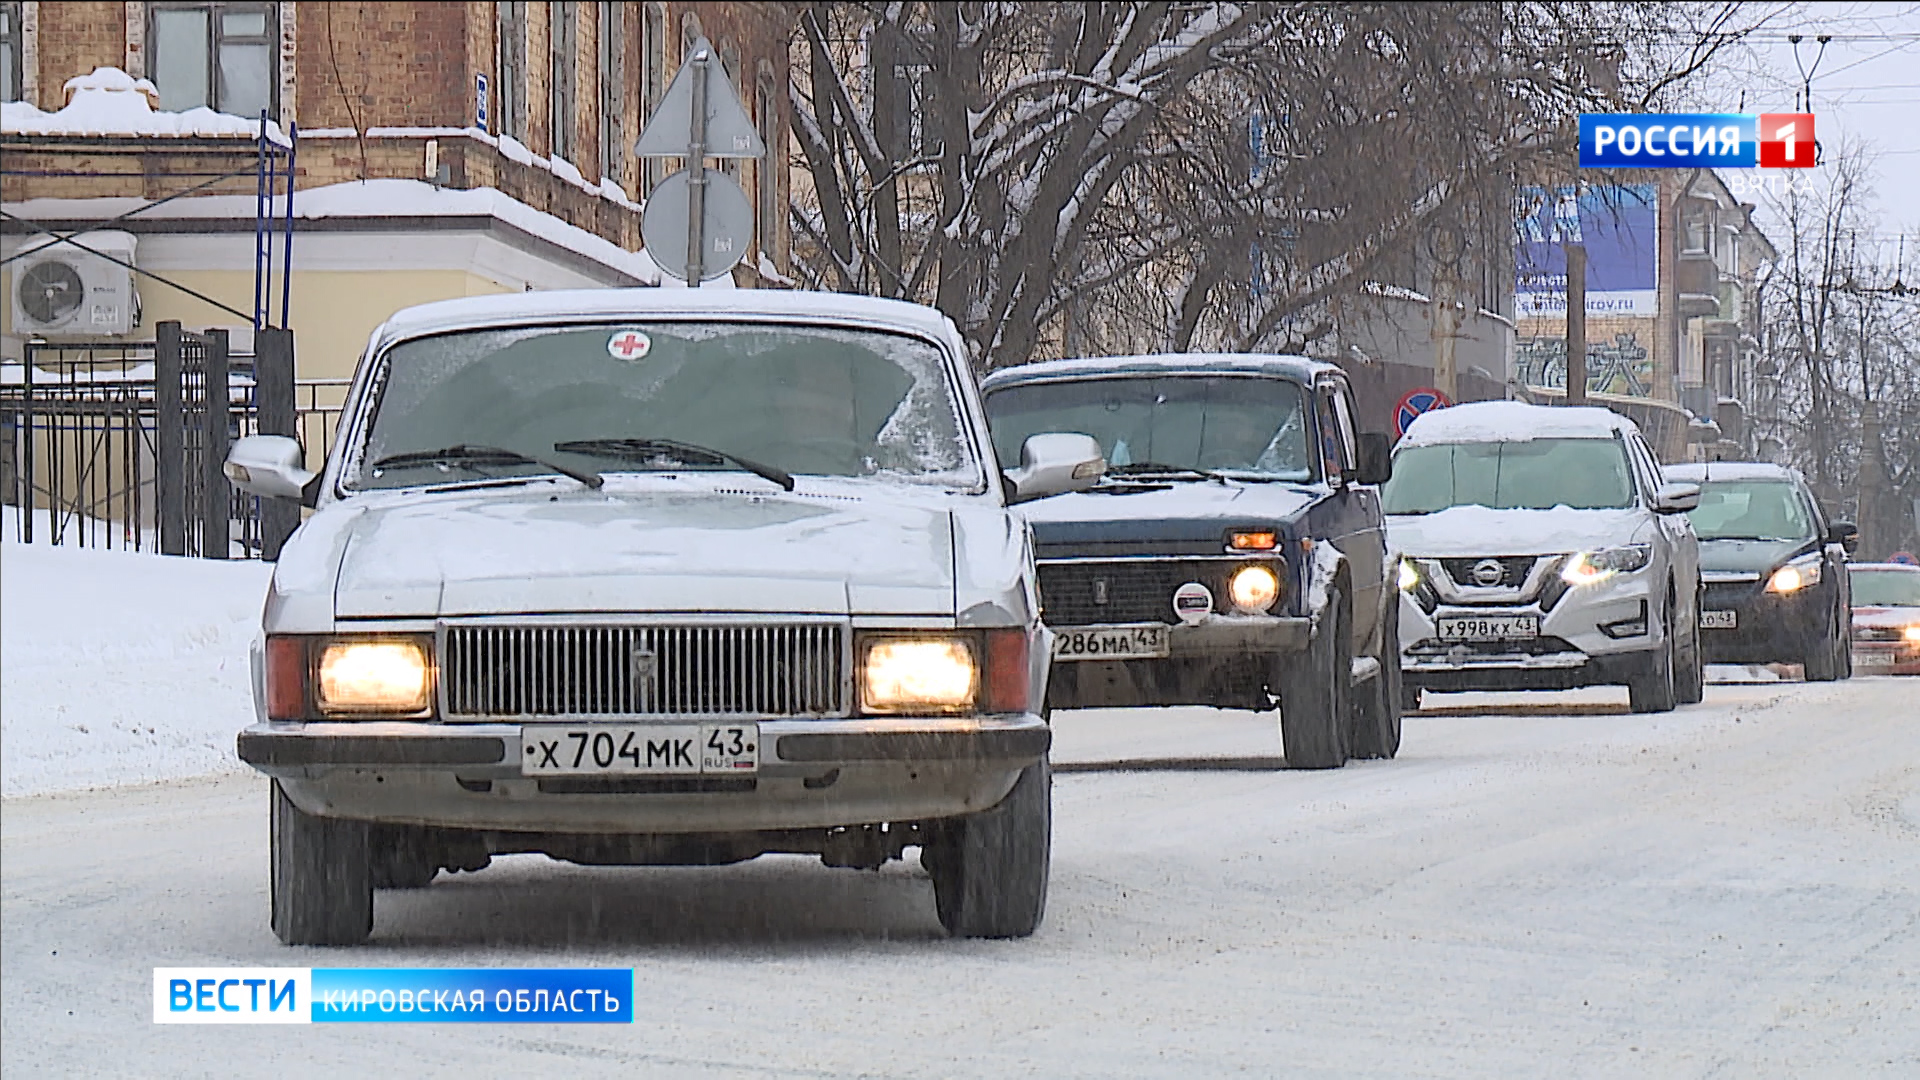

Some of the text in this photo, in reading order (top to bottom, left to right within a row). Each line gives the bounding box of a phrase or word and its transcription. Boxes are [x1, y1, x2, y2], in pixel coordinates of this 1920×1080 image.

[1136, 629, 1157, 646] 43
[707, 729, 744, 756] 43
[704, 757, 732, 768] RUS
